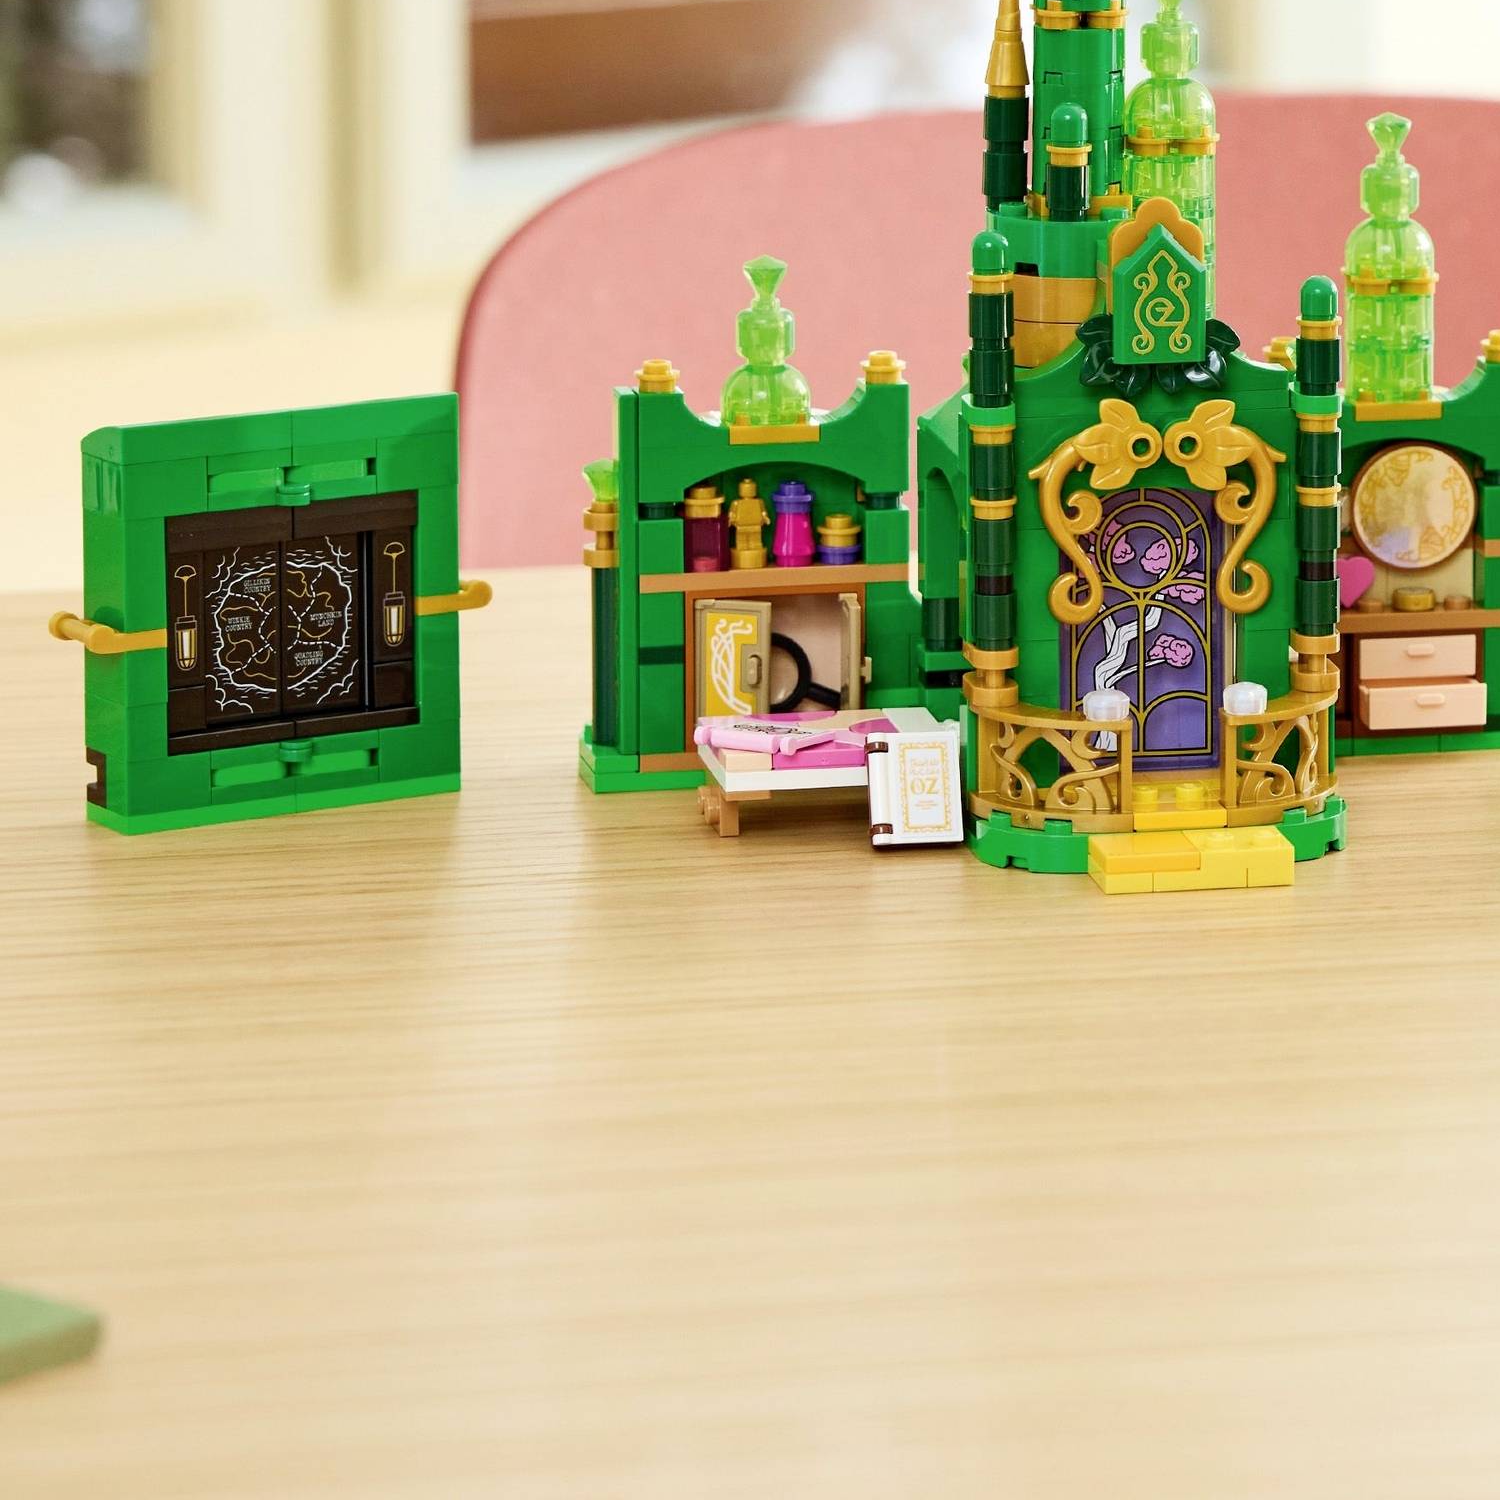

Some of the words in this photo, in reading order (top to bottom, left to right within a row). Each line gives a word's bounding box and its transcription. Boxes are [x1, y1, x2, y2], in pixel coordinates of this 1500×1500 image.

[244, 585, 271, 593] COUNTRY
[225, 623, 252, 632] COUNTRY
[295, 658, 323, 666] COUNTRY
[910, 776, 939, 795] OZ
